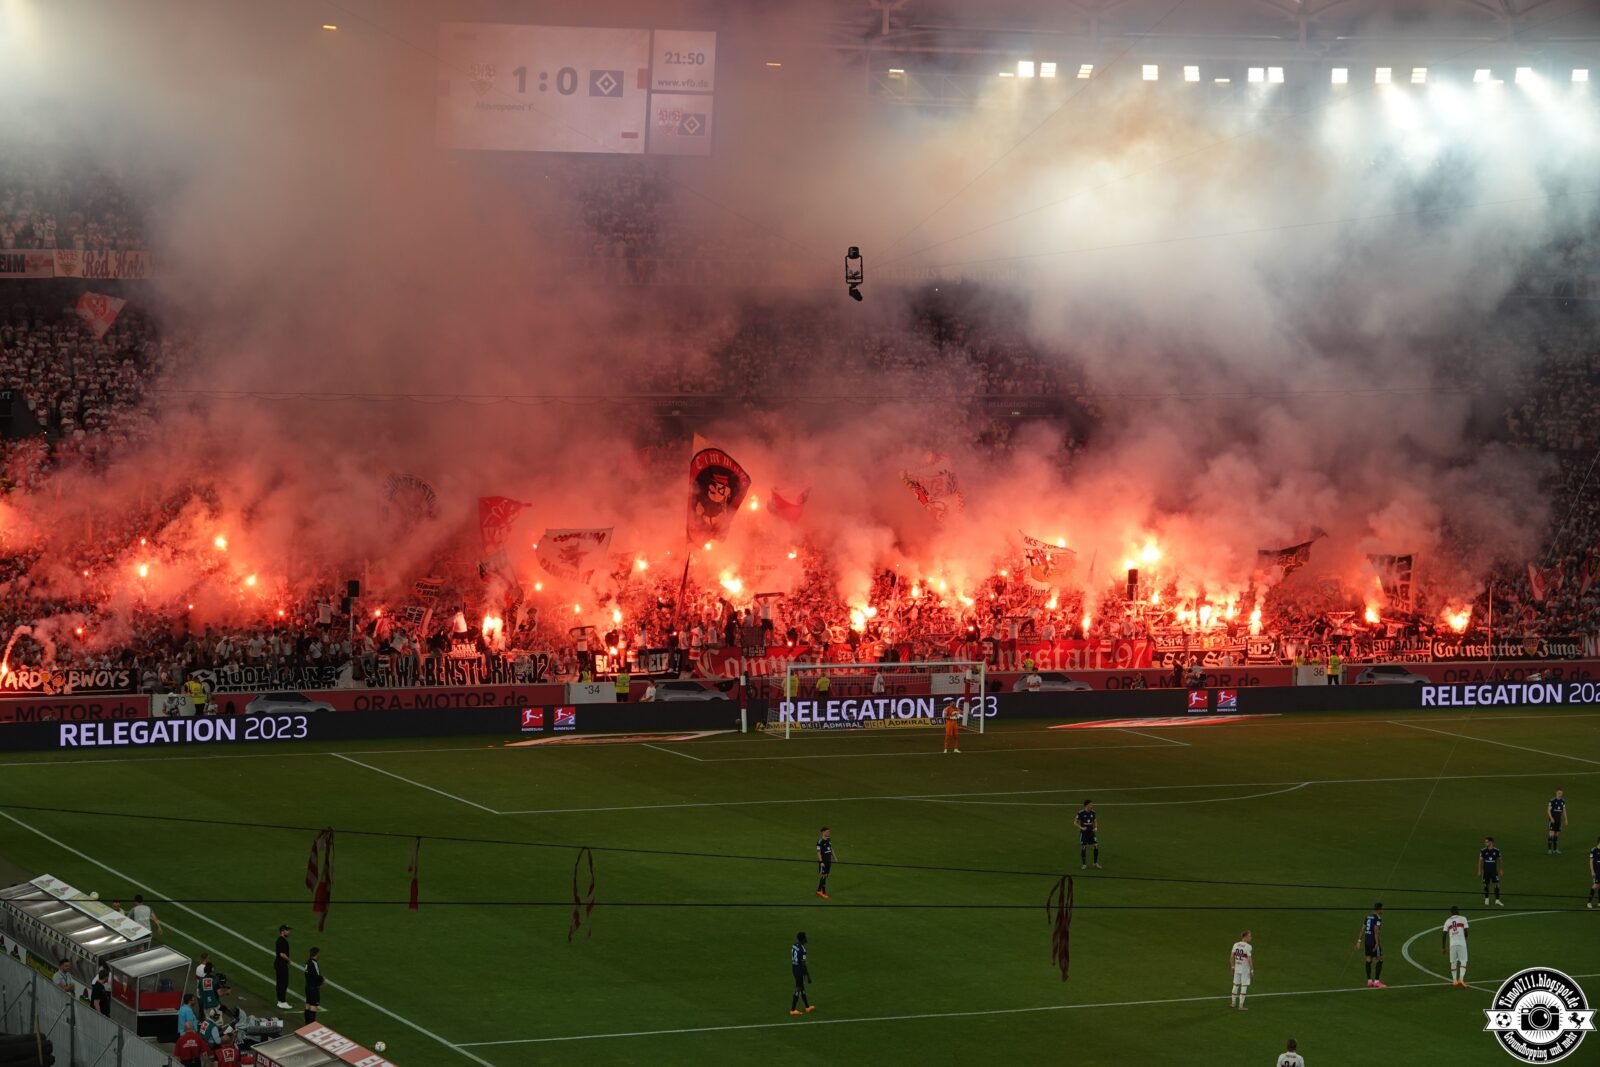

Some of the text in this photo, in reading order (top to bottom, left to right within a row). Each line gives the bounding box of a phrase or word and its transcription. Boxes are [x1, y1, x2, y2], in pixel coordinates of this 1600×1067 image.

[664, 52, 705, 65] 21:50
[657, 78, 709, 88] www.vfb.de
[82, 248, 109, 279] Red
[1116, 642, 1147, 669] 97
[1537, 638, 1582, 658] Jungs
[68, 670, 130, 688] BWOYS
[949, 675, 960, 684] 35
[1313, 668, 1324, 677] 36
[354, 691, 528, 712] ORA-MOTOR.de
[1421, 683, 1562, 706] RELEGATION
[779, 697, 934, 722] RELEGATION
[60, 716, 308, 747] RELEGATION 2023
[823, 720, 864, 730] ADMIRAL
[888, 717, 929, 727] ADMIRAL
[931, 718, 945, 726] BE
[303, 1027, 358, 1056] ELTEN
